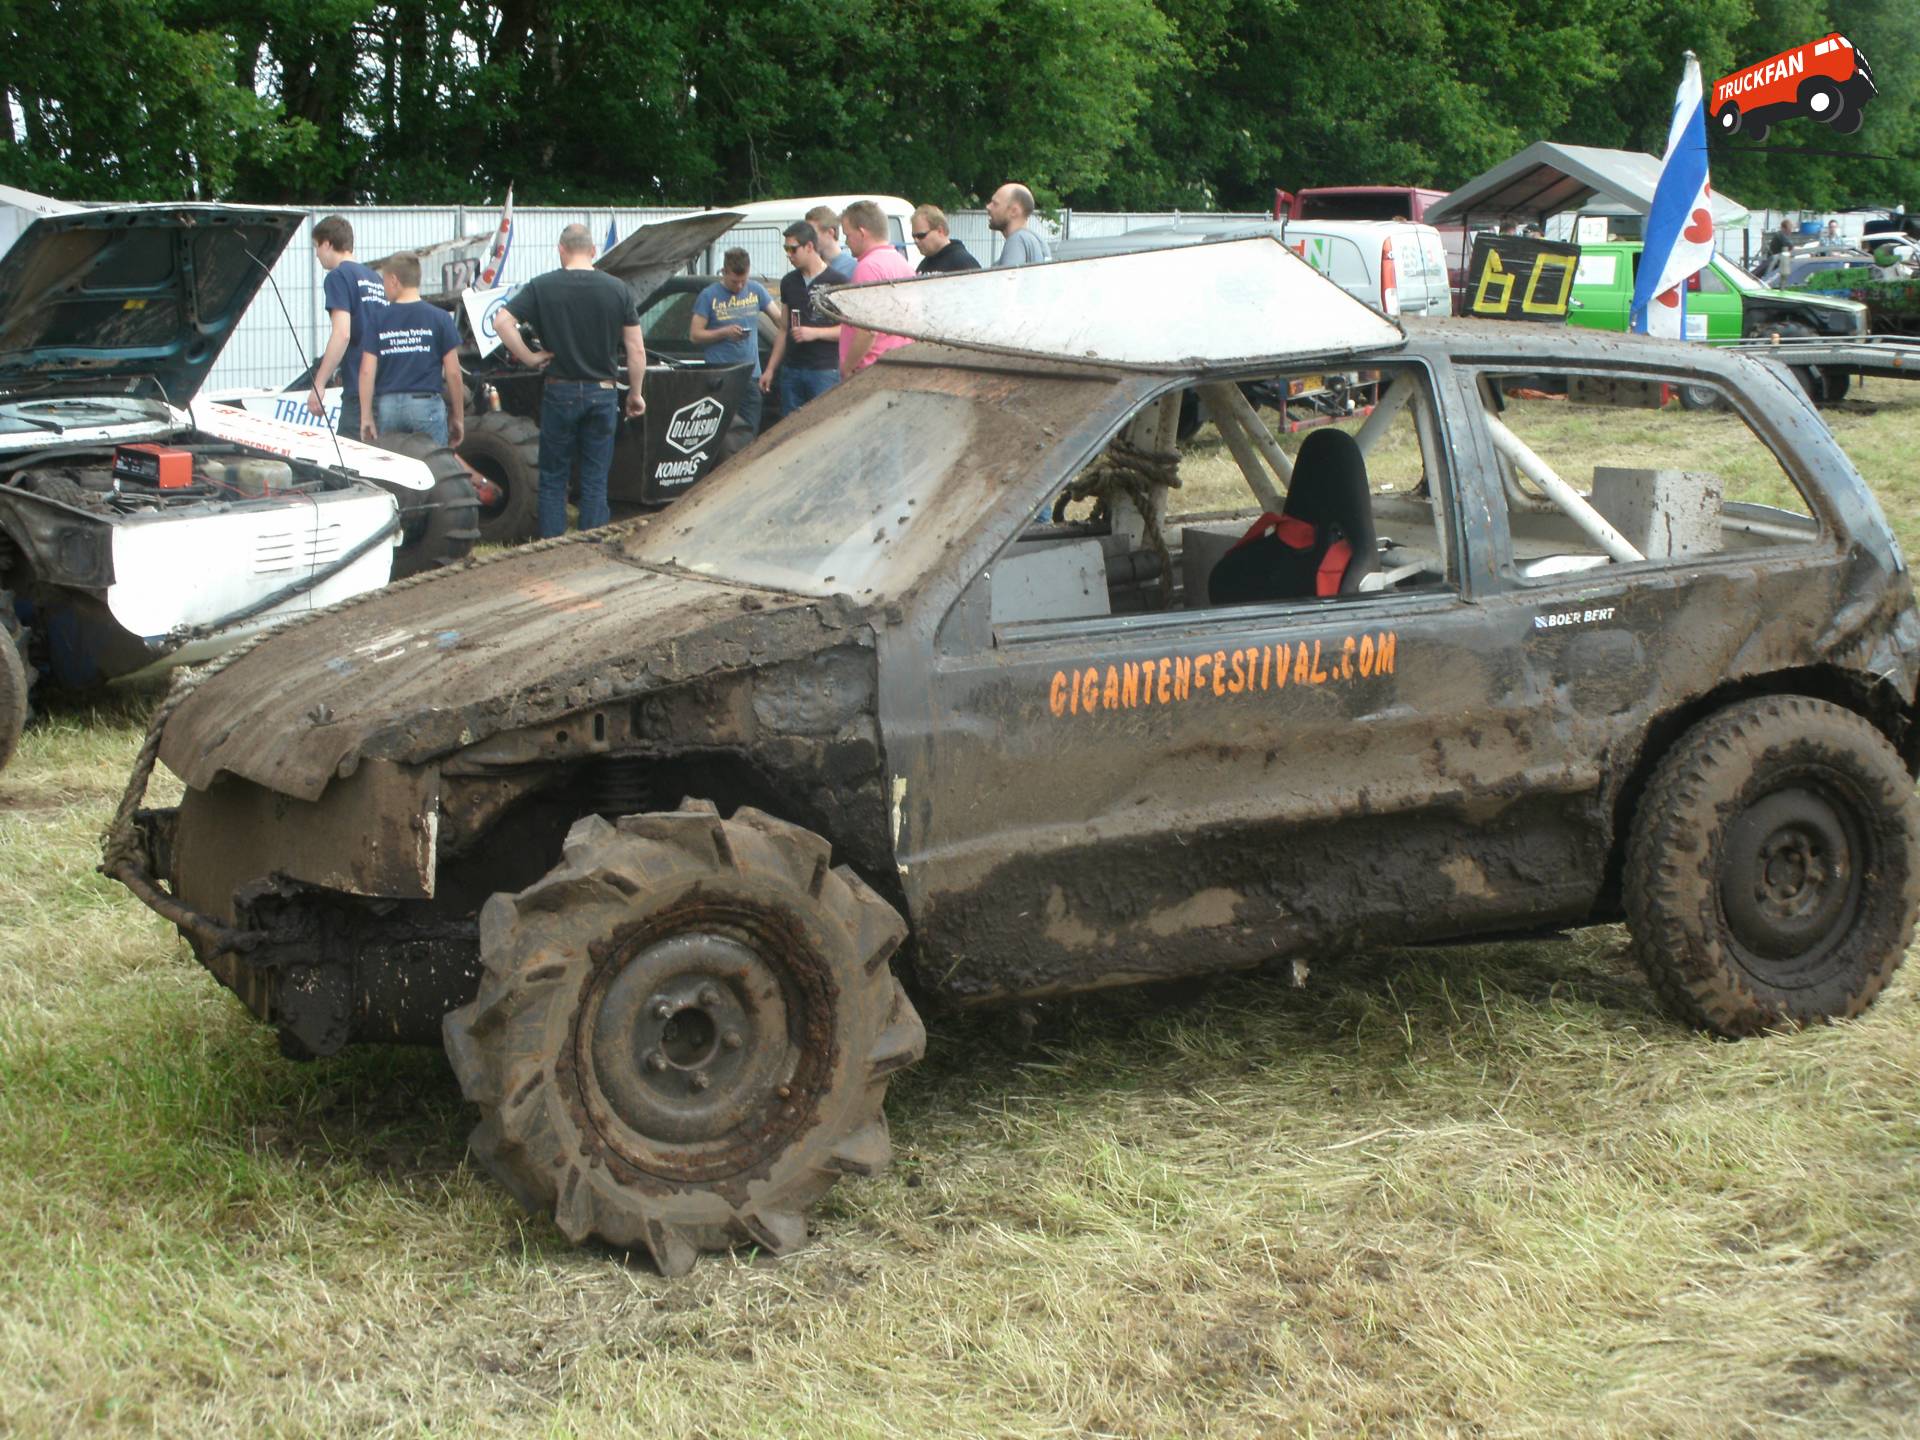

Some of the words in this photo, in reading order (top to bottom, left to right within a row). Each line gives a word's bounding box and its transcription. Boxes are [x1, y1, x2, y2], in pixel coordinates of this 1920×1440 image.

[1472, 248, 1578, 316] 60
[654, 458, 701, 479] KOMPAS
[1548, 612, 1582, 627] BOER
